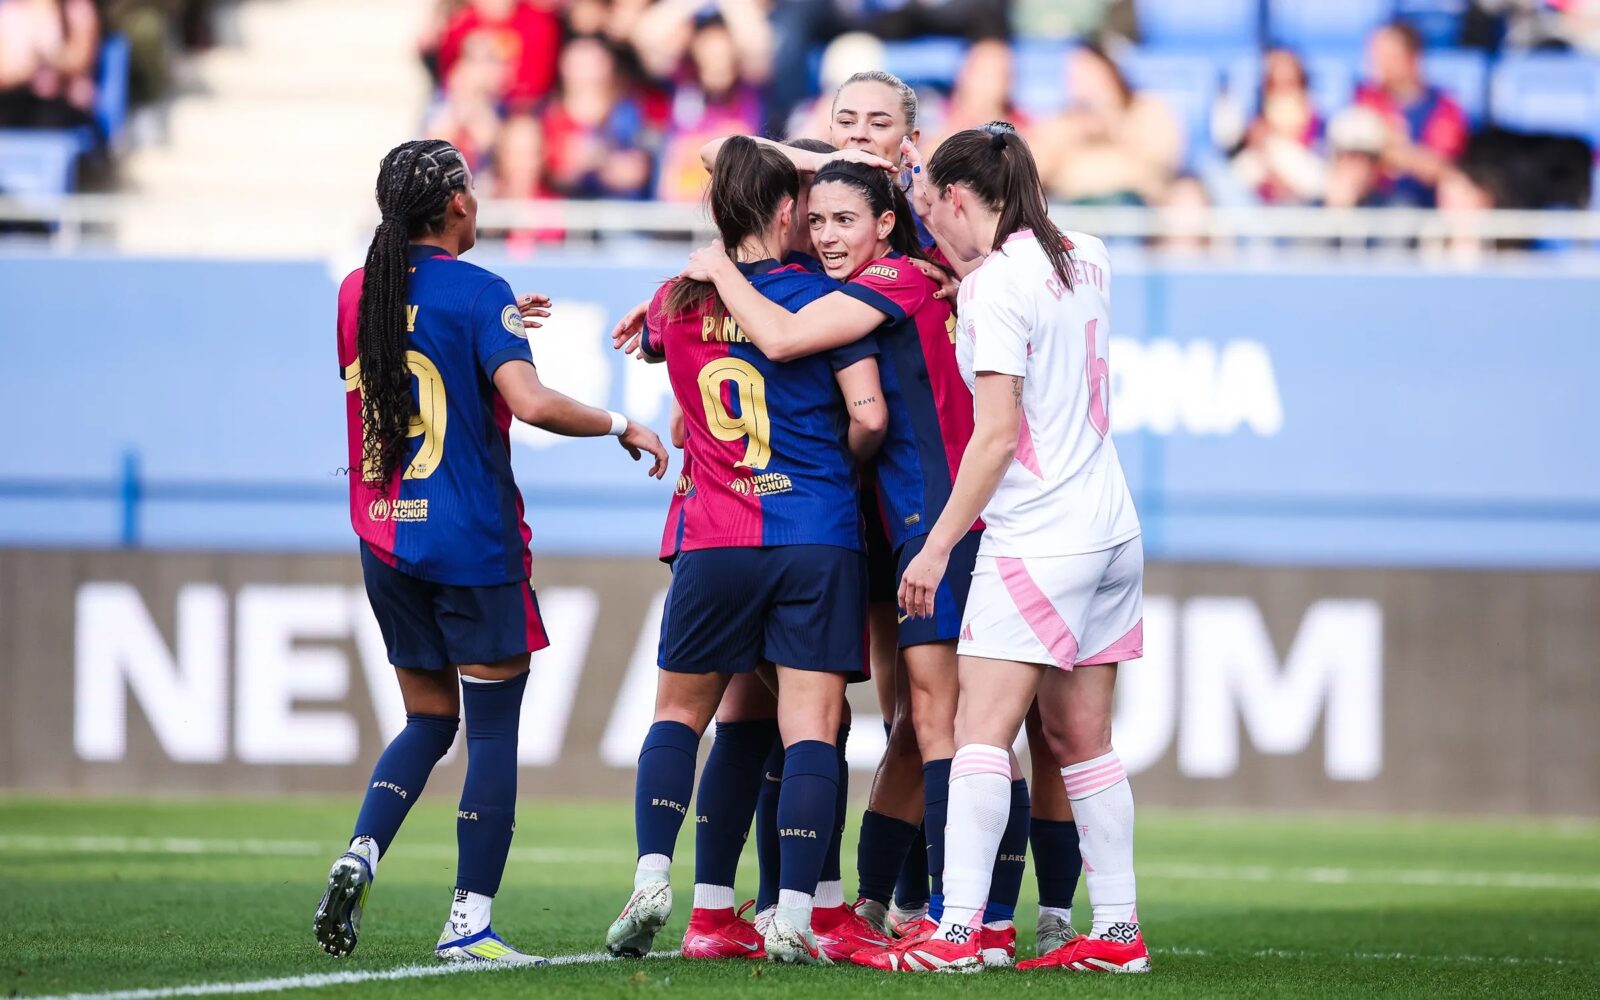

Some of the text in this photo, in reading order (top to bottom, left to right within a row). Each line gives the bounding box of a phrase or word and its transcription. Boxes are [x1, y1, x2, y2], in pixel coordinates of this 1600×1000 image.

[863, 266, 898, 279] IMBO
[1085, 318, 1109, 440] 6
[853, 396, 876, 406] BRAVE
[697, 356, 771, 470] 9
[750, 472, 789, 485] UNHCR
[752, 480, 792, 494] ACNUR
[392, 499, 428, 509] UNHCR
[391, 508, 428, 518] ACNUR
[373, 781, 406, 799] BARÇA
[652, 798, 686, 816] BARÇA
[456, 810, 478, 821] RÇA
[780, 828, 817, 839] BARÇA
[1000, 853, 1026, 863] BARÇ
